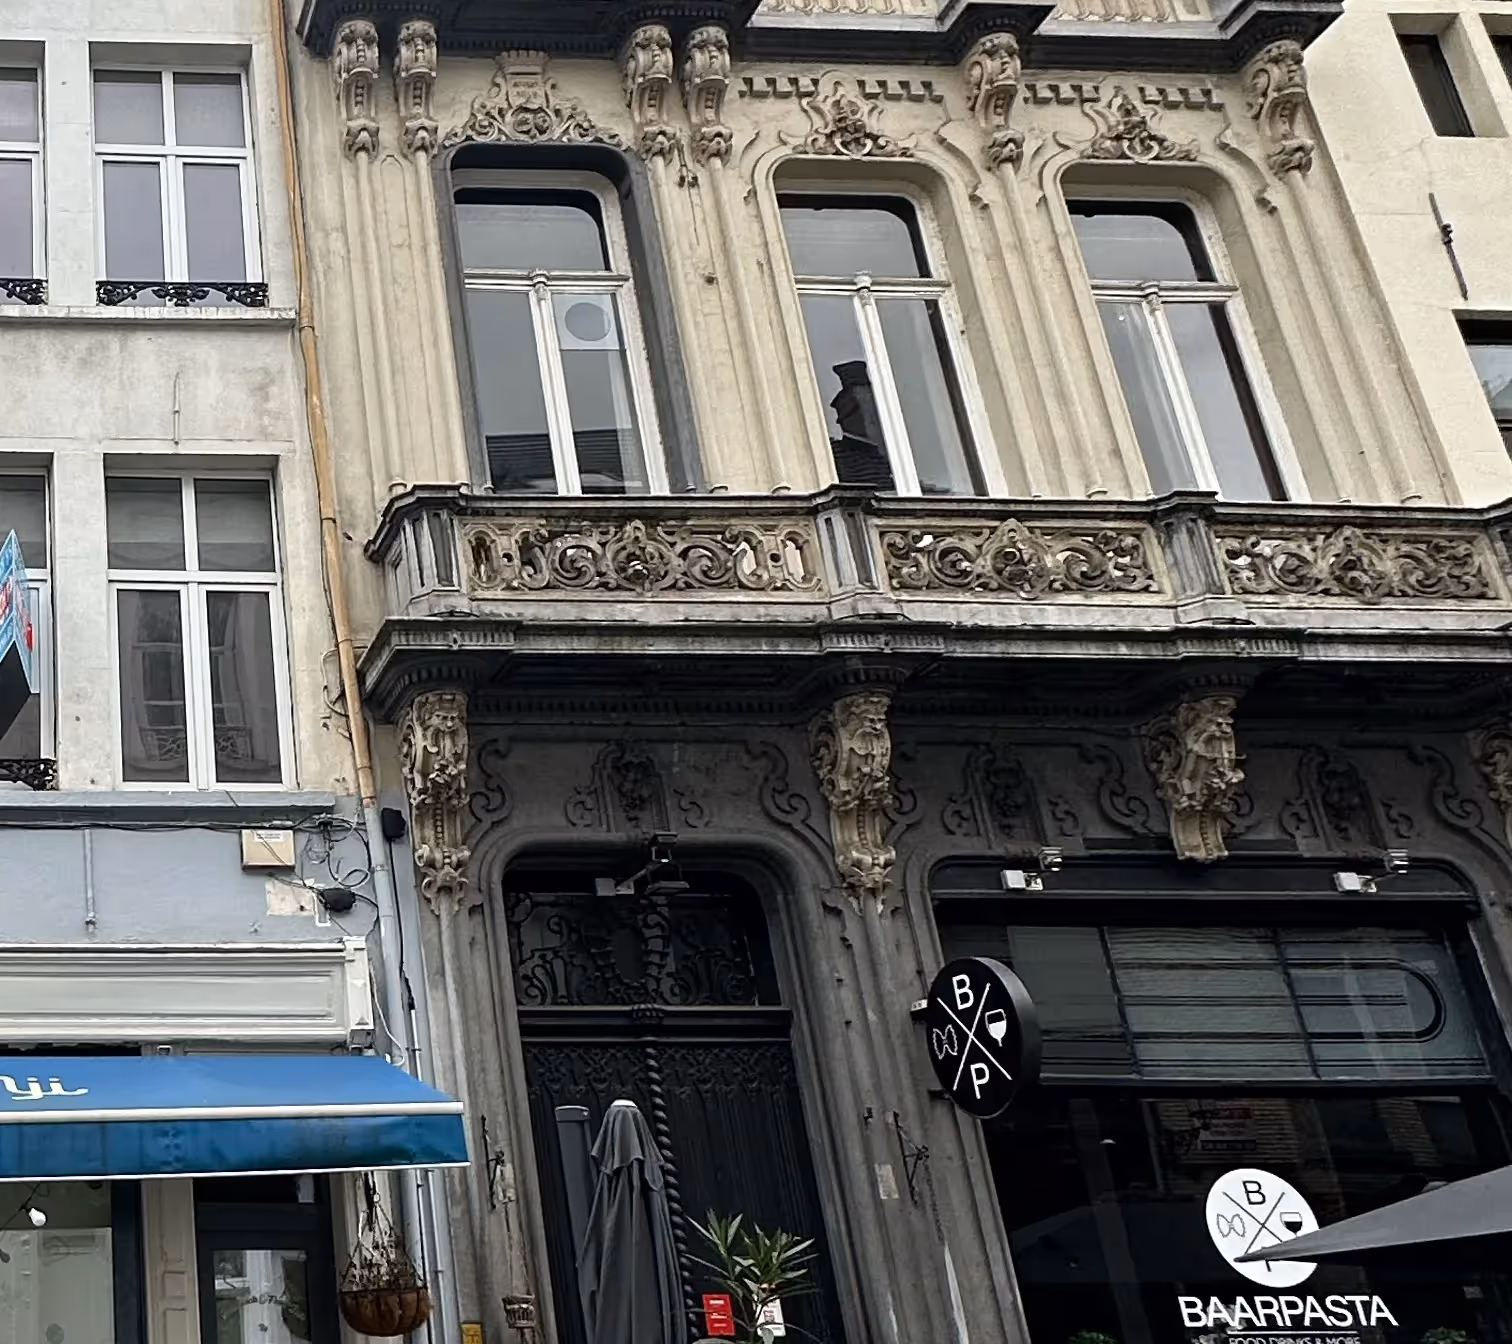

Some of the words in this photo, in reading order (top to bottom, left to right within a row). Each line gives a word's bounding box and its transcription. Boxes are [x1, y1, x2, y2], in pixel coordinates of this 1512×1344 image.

[952, 974, 975, 1010] B
[970, 1062, 990, 1099] P
[1242, 1180, 1266, 1205] B
[1177, 1295, 1400, 1328] BAARPASTA
